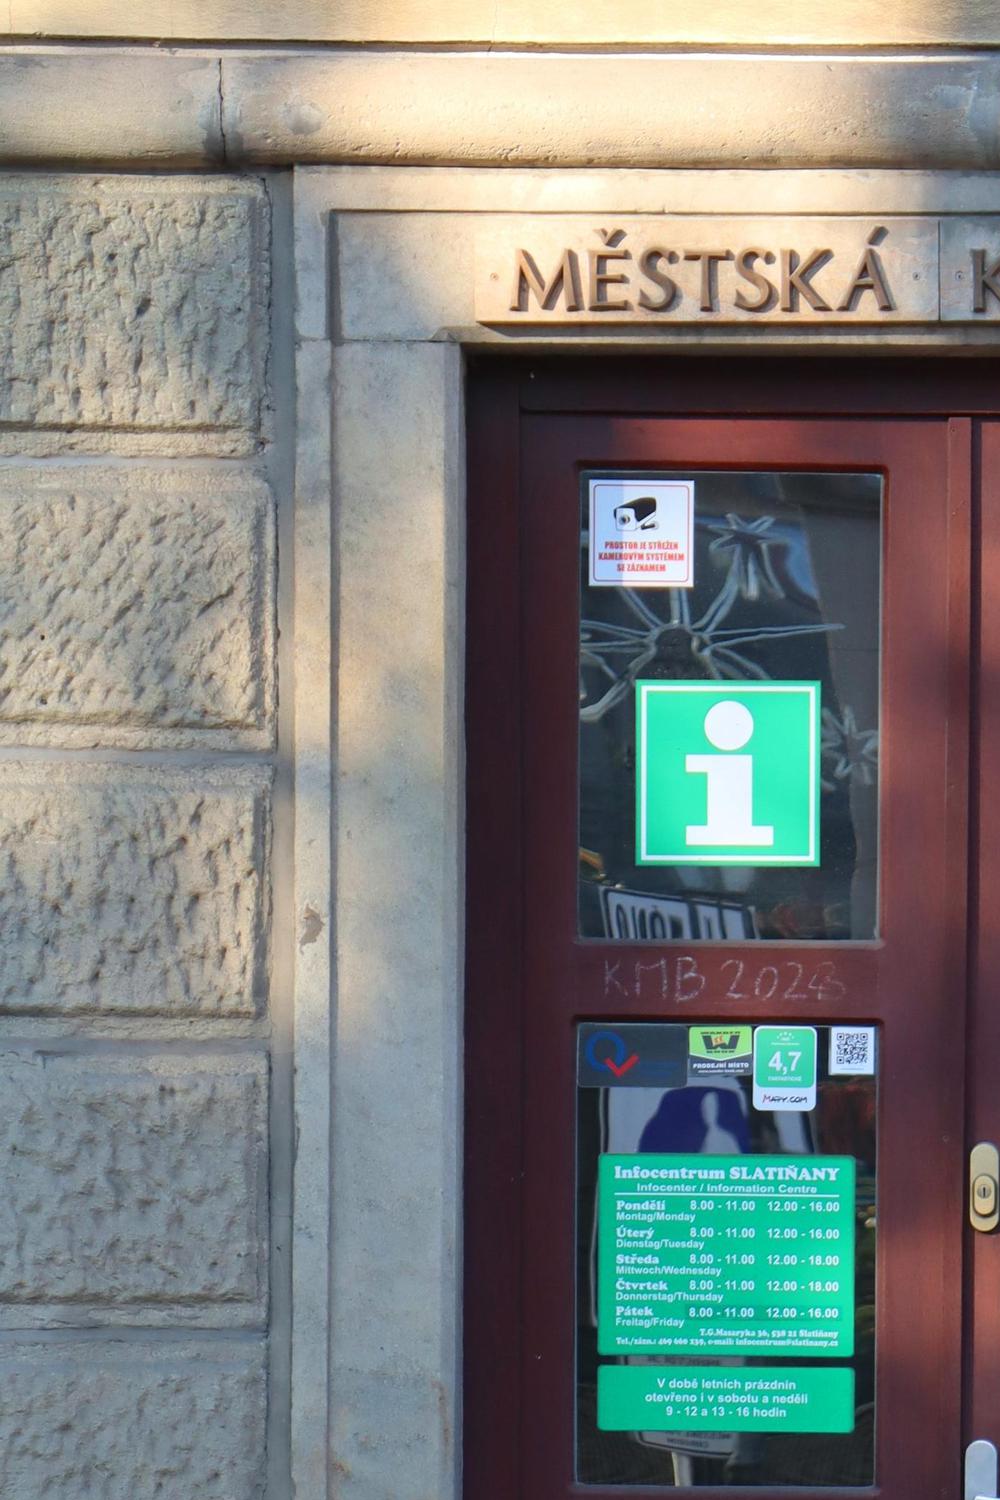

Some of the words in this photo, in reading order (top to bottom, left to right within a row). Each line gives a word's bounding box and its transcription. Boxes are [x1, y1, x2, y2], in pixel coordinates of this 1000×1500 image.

[510, 226, 897, 313] MĚSTSKÁ
[605, 541, 638, 549] PROSTOR
[640, 541, 647, 549] JE
[649, 540, 679, 549] STŘEŽEN
[599, 552, 644, 561] KAMEROVÝM
[646, 552, 685, 561] SYSTÉMEM
[617, 564, 625, 572] SE
[627, 563, 666, 572] ZÁZNAMEM
[604, 956, 706, 1001] KMB
[728, 1061, 749, 1069] MÍSTO
[768, 1051, 801, 1075] 4,7
[614, 1165, 725, 1180] Infocentrum
[729, 1165, 840, 1181] SLATIŇANY
[637, 1183, 696, 1192] Infocenter
[707, 1184, 774, 1193] Information
[778, 1185, 817, 1194] Centre
[616, 1199, 666, 1211] Pondělí
[690, 1200, 714, 1211] 8.00
[725, 1200, 755, 1211] 11.00
[767, 1201, 798, 1212] 12.00
[809, 1201, 840, 1212] 16.00
[616, 1211, 695, 1222] Montag/Monday
[616, 1225, 654, 1240] Úterý
[690, 1227, 714, 1238] 8.00
[725, 1228, 755, 1238] 11.00
[767, 1228, 798, 1239] 12.00
[809, 1229, 840, 1240] 16.00
[616, 1239, 704, 1250] Dienstag/Tuesday
[616, 1253, 659, 1265] Středa
[689, 1254, 714, 1265] 8.00
[725, 1254, 755, 1265] 11.00
[767, 1255, 797, 1266] 12.00
[809, 1256, 839, 1266] 18.00
[616, 1265, 721, 1277] Mittwoch/Wednesday
[616, 1278, 668, 1291] Čtvrtek
[689, 1280, 713, 1291] 8.00
[724, 1280, 755, 1291] 11.00
[766, 1281, 797, 1291] 12.00
[808, 1281, 839, 1292] 18.00
[616, 1291, 723, 1303] Donnerstag/Thursday
[616, 1305, 653, 1316] Pátek
[688, 1307, 713, 1318] 8.00
[724, 1307, 754, 1318] 11.00
[766, 1308, 797, 1318] 12.00
[808, 1308, 838, 1318] 16.00
[616, 1317, 684, 1328] Freitag/Friday
[700, 1328, 755, 1338] T.G.Masaryka
[798, 1329, 838, 1340] Slatiňany
[657, 1378, 666, 1388] V
[669, 1378, 698, 1389] době
[701, 1379, 741, 1389] letních
[745, 1379, 796, 1391] prázdnin
[645, 1392, 697, 1402] otevřeno
[707, 1394, 714, 1402] v
[717, 1393, 758, 1403] sobotu
[762, 1395, 769, 1403] a
[772, 1393, 808, 1404] neděli
[666, 1406, 673, 1416] 9
[685, 1407, 698, 1416] 12
[700, 1409, 708, 1417] a
[711, 1407, 725, 1417] 13
[736, 1407, 750, 1417] 16
[753, 1407, 787, 1417] hodin
